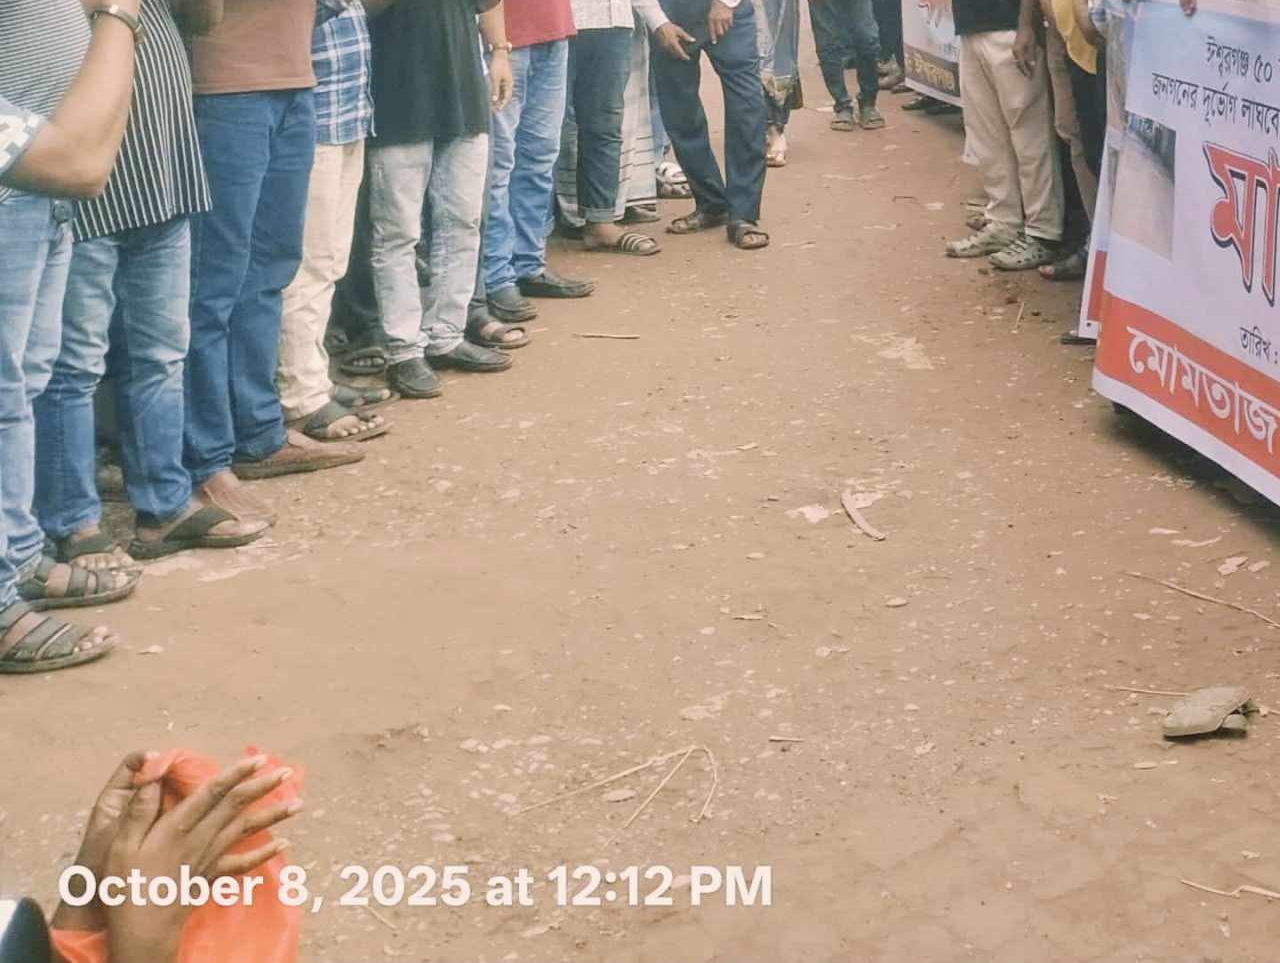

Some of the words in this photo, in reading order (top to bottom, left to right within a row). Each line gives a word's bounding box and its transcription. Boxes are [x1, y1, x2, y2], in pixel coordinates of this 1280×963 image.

[1205, 36, 1250, 80] ঈশ্বরগঞ্জ
[1254, 53, 1273, 84] ৫০
[1241, 93, 1280, 135] লাঘবে
[1240, 326, 1271, 356] তারিখ
